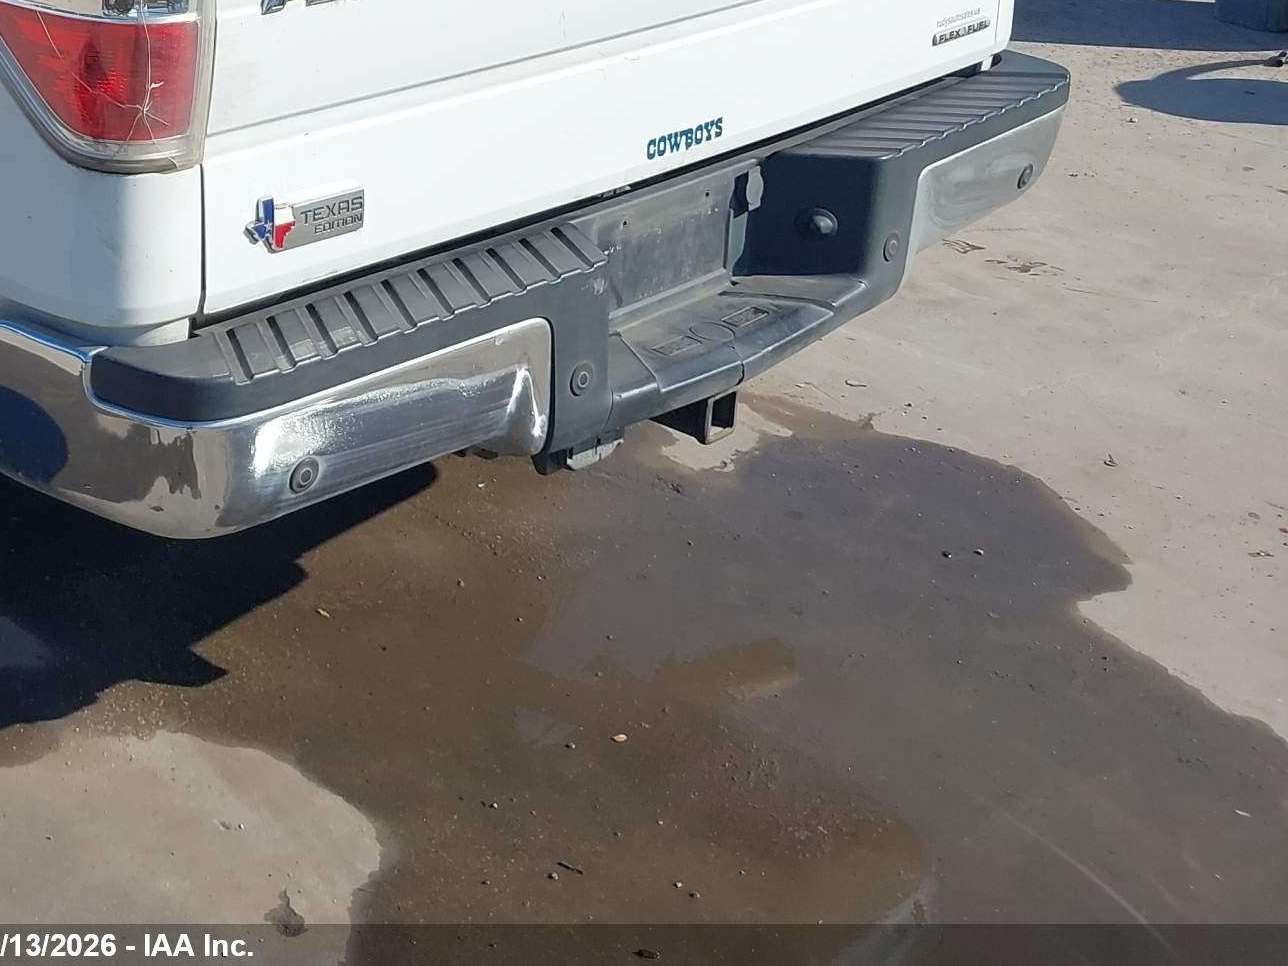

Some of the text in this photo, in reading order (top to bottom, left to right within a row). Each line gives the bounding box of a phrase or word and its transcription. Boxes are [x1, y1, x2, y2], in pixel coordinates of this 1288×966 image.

[938, 18, 989, 45] FLEX FUEL
[646, 116, 723, 160] COWBOYS
[300, 196, 363, 224] TEXAS
[314, 213, 363, 234] EDITION
